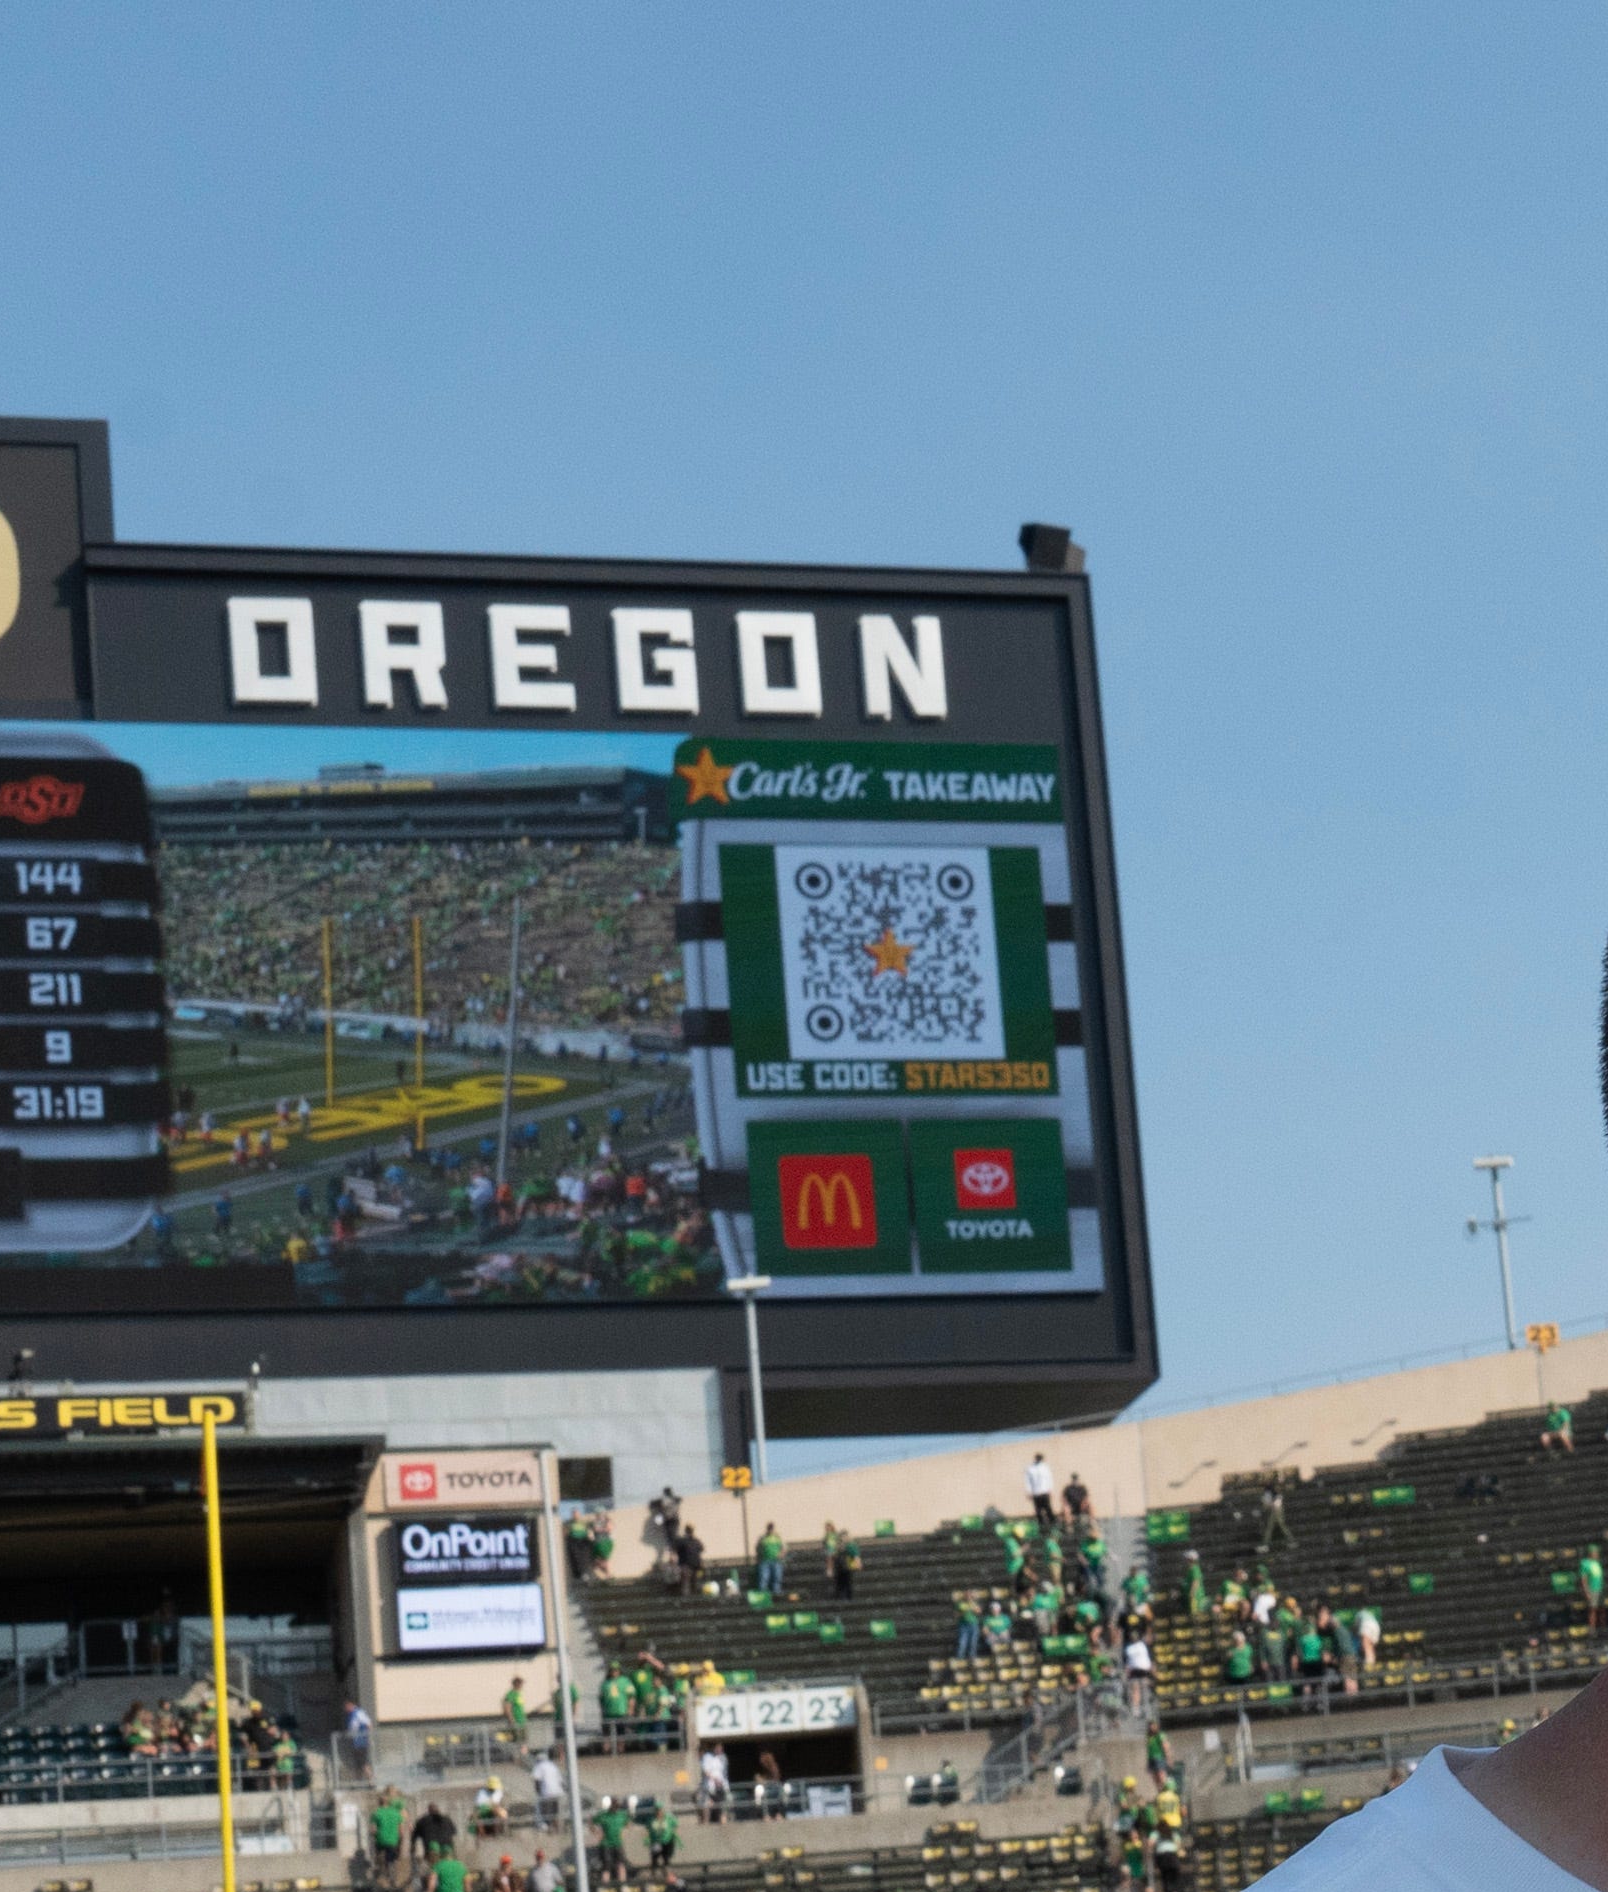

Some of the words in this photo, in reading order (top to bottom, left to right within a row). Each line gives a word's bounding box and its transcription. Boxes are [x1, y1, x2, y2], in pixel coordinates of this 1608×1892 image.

[226, 597, 948, 720] OREGON
[883, 770, 1055, 802] TAKEAWAY
[14, 861, 83, 895] 144
[26, 917, 79, 951] 67
[28, 973, 83, 1006] 211
[43, 1030, 73, 1065] 9
[746, 1062, 805, 1091] USE
[814, 1062, 898, 1091] CODE:
[12, 1085, 105, 1121] 31:19
[945, 1219, 1034, 1240] TOYOTA
[56, 1395, 238, 1430] FIELD
[445, 1470, 533, 1489] TOYOTA
[401, 1523, 530, 1560] OnPoint
[708, 1704, 740, 1729] 21
[759, 1700, 793, 1726] 22
[809, 1696, 844, 1722] 23
